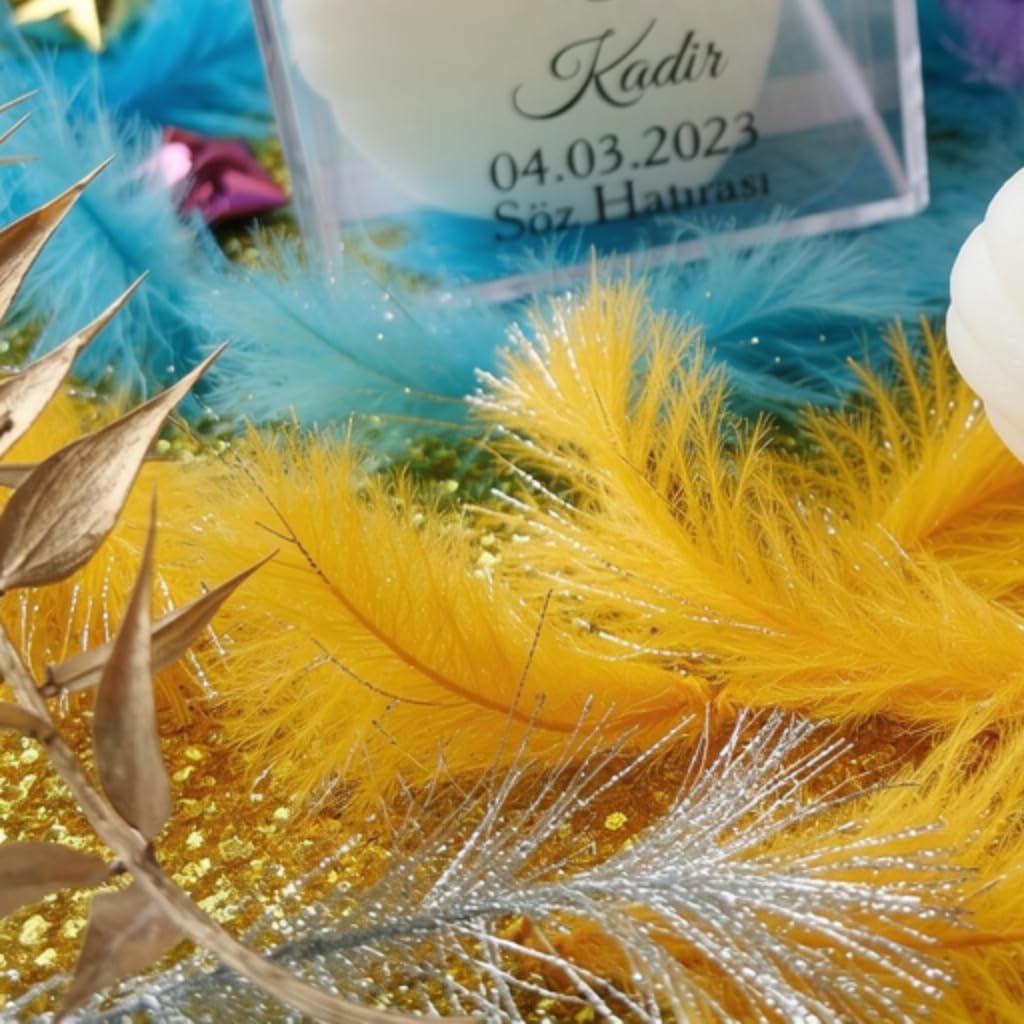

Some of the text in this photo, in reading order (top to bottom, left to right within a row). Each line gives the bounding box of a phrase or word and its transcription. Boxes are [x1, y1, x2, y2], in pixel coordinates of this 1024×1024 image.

[512, 17, 729, 121] Kadir
[490, 111, 759, 193] 04.03.2023
[493, 200, 575, 242] Söz
